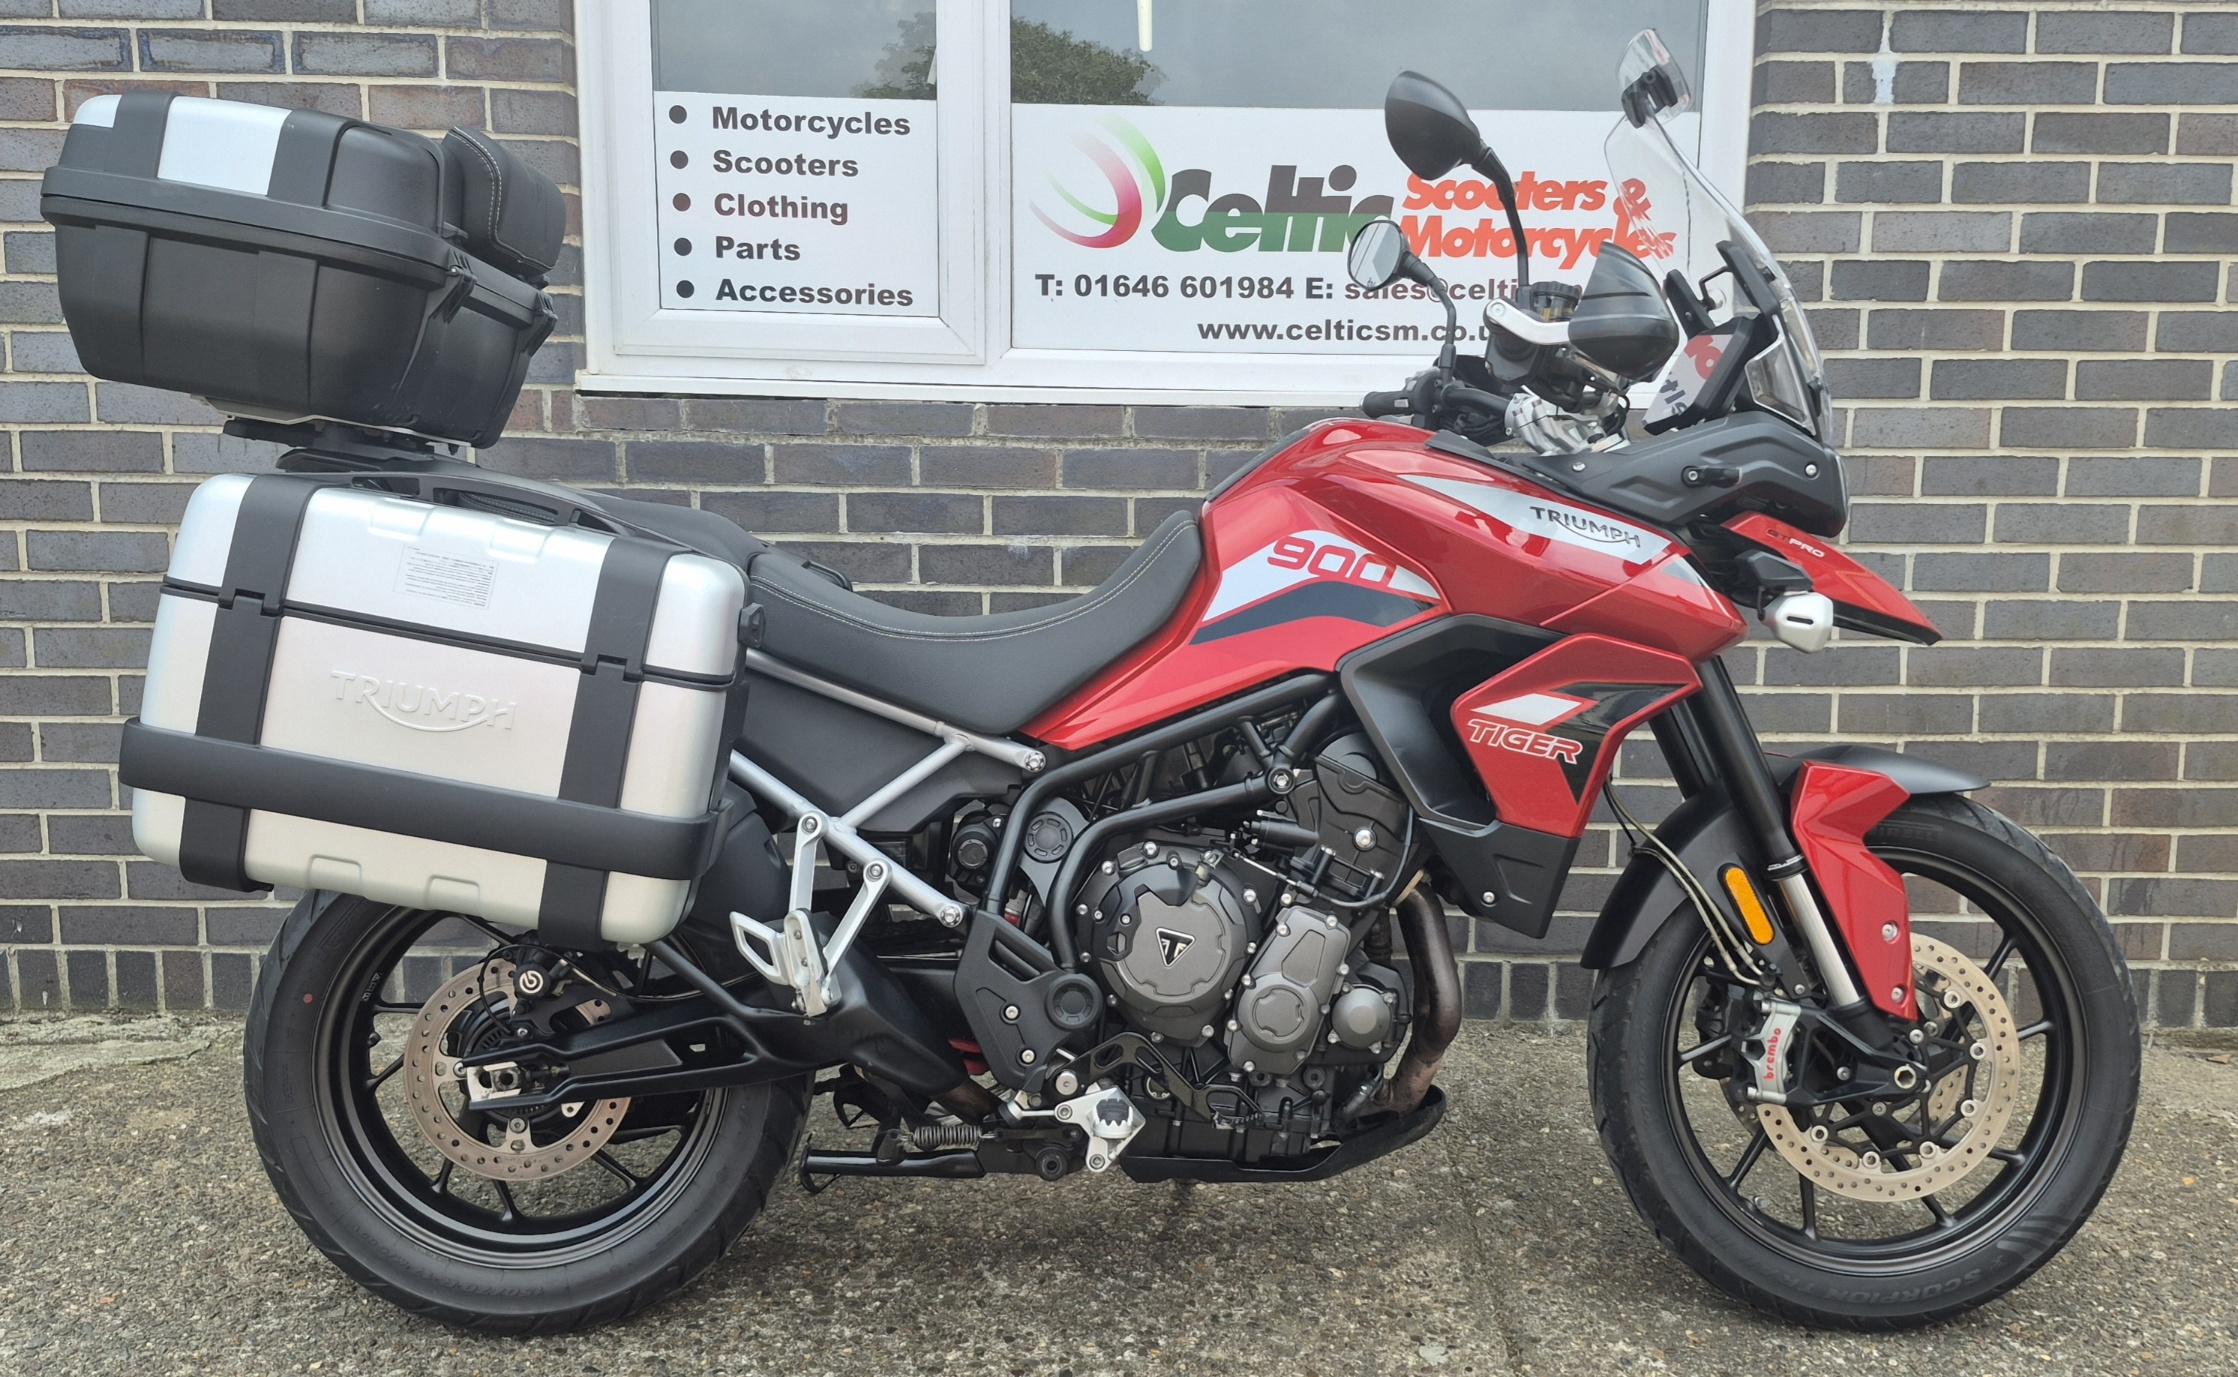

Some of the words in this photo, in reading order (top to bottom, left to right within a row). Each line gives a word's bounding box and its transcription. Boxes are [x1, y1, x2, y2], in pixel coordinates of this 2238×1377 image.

[712, 105, 911, 139] Motorcycles
[712, 149, 859, 177] Scooters
[714, 192, 849, 226] Clothing
[1151, 164, 1394, 253] Celtic
[715, 236, 801, 262] Parts
[715, 278, 914, 307] Accessories
[1035, 273, 1063, 297] T:
[1074, 273, 1170, 298] 01646
[1180, 275, 1294, 300] 601984
[1306, 276, 1333, 300] E:
[1530, 506, 1640, 548] TRIUMPH
[1267, 535, 1396, 586] 900
[1789, 537, 1825, 558] PRO
[330, 670, 517, 732] TRIUMPH
[1467, 718, 1583, 765] TIGER
[1763, 1028, 1782, 1080] brembo
[1825, 1267, 1981, 1304] SCORPION
